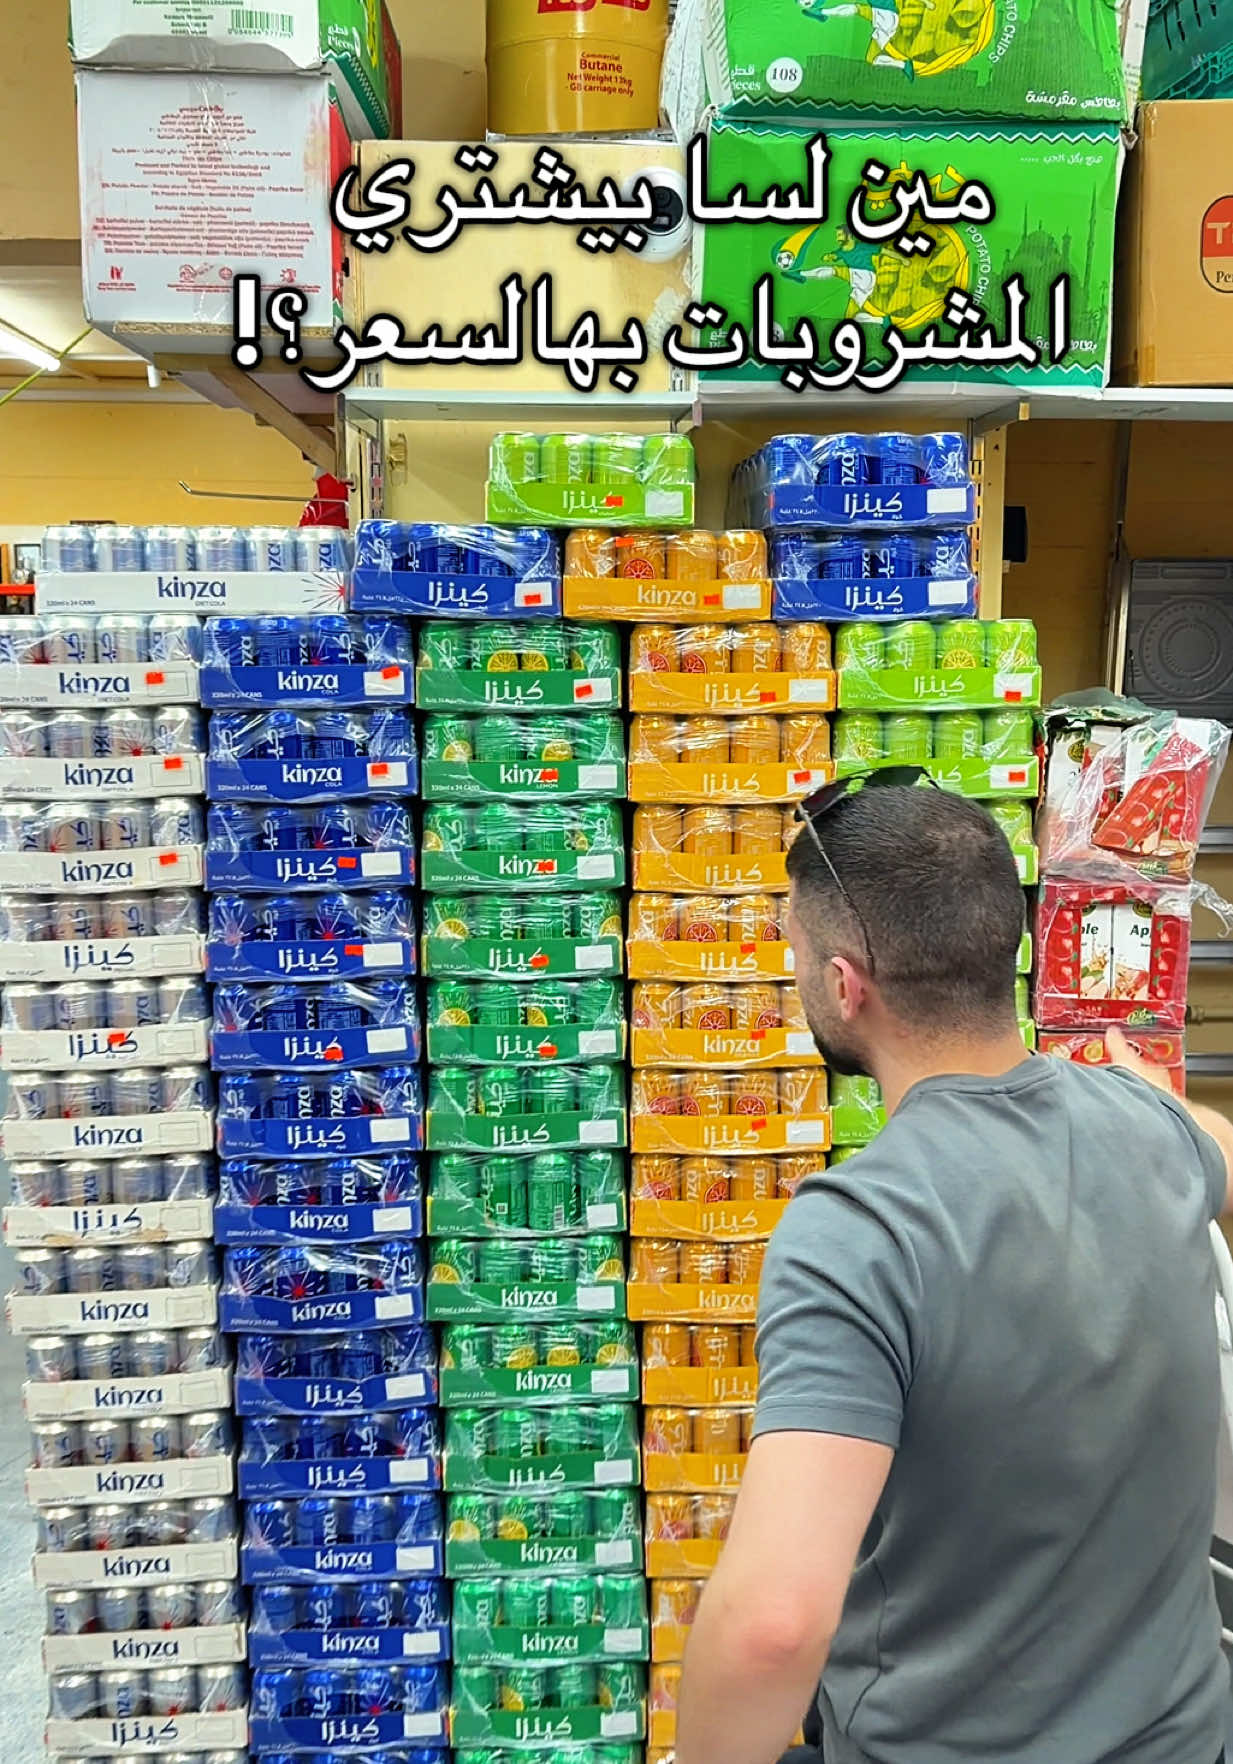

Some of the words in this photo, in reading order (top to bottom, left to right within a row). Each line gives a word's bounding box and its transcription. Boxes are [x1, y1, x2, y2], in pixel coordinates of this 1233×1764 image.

[988, 25, 1016, 64] CHIPS
[580, 59, 622, 73] Butane
[773, 68, 797, 81] 108
[583, 73, 612, 84] Weight
[584, 85, 617, 95] carriage
[733, 81, 760, 91] ieces
[1025, 90, 1078, 107] مقرمشة
[1208, 222, 1233, 244] T
[966, 225, 991, 273] POTATO
[973, 277, 990, 305] CHIP
[844, 492, 903, 519] كينزا
[157, 576, 226, 600] kinza
[429, 581, 488, 607] كينزا
[637, 585, 697, 606] kinza
[845, 586, 904, 611] كينزا
[59, 672, 130, 696] kinza
[277, 670, 339, 692] kinza
[485, 679, 544, 706] كينزا
[914, 674, 965, 697] كينزا
[704, 683, 761, 708] كينزا
[64, 763, 134, 787] kinza
[282, 763, 342, 786] kinza
[704, 773, 761, 796] كينزا
[61, 860, 134, 884] kinza
[276, 856, 337, 882] كينزا
[705, 863, 763, 887] كينزا
[1130, 925, 1150, 938] Ap
[65, 943, 135, 972] كينزا
[278, 947, 338, 973] كينزا
[701, 952, 759, 975] كينزا
[69, 1031, 138, 1060] كينزا
[284, 1036, 343, 1061] كينزا
[704, 1034, 760, 1055] kinza
[74, 1125, 143, 1148] kinza
[287, 1124, 346, 1149] كينزا
[493, 1123, 550, 1147] كينزا
[704, 1125, 761, 1147] كينزا
[74, 1208, 142, 1238] كينزا
[290, 1210, 349, 1232] kinza
[702, 1209, 758, 1234] كينزا
[501, 1286, 558, 1308] kinza
[699, 1289, 755, 1312] kinza
[81, 1300, 149, 1322] kinza
[291, 1299, 351, 1322] kinza
[516, 1369, 572, 1393] kinza
[714, 1376, 754, 1400] ينزا
[94, 1386, 162, 1408] kinza
[305, 1383, 364, 1408] كينزا
[97, 1471, 164, 1493] kinza
[308, 1463, 367, 1489] كينزا
[714, 1464, 742, 1487] نزا
[315, 1549, 372, 1571] kinza
[521, 1543, 577, 1564] kinza
[103, 1555, 170, 1578] kinza
[113, 1638, 179, 1660] kinza
[322, 1632, 380, 1654] kinza
[522, 1633, 578, 1654] kinza
[111, 1719, 179, 1744] كينزا
[321, 1716, 380, 1742] كينزا
[515, 1716, 572, 1742] كينزا
